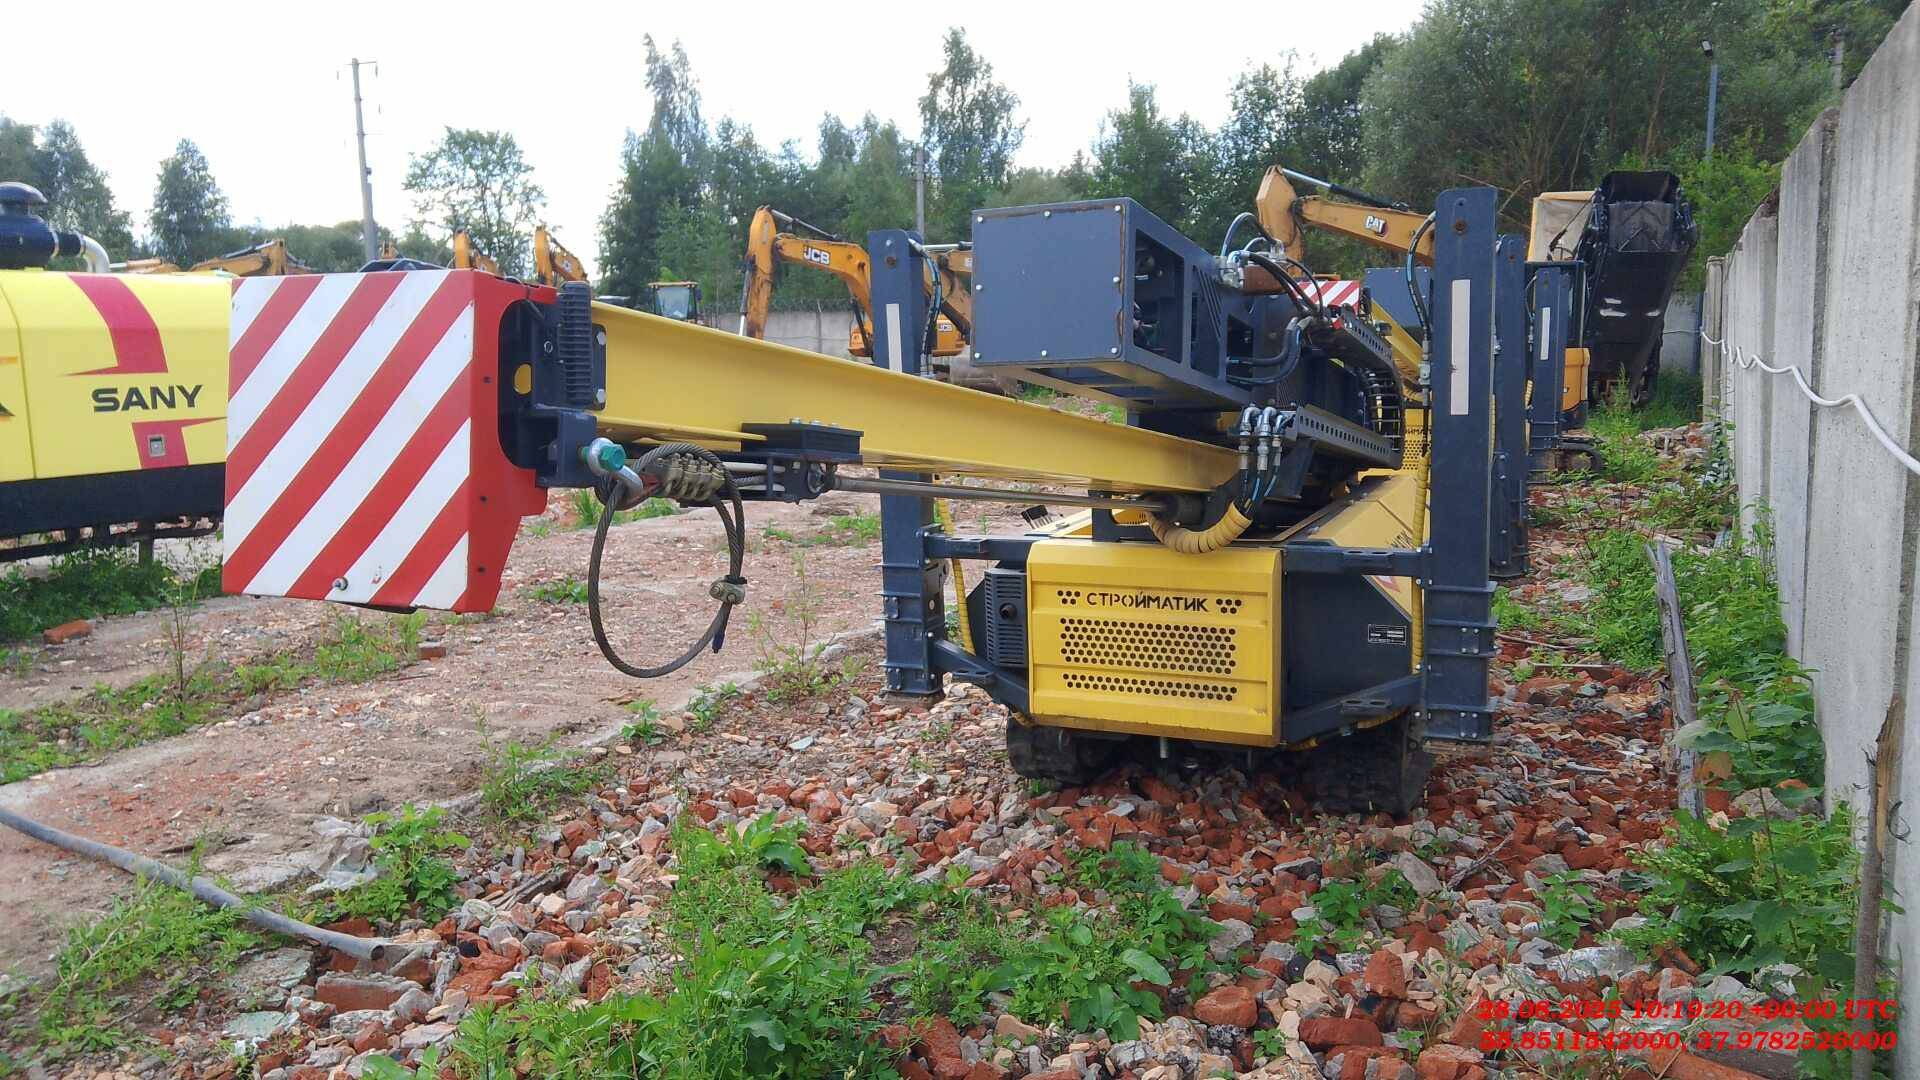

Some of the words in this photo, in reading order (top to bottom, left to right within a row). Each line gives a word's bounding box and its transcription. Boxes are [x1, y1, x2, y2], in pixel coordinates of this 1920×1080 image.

[1365, 215, 1386, 233] CAT
[803, 246, 830, 265] JCB
[91, 384, 203, 412] SANY
[1086, 591, 1209, 612] СТРОЙМАТИК
